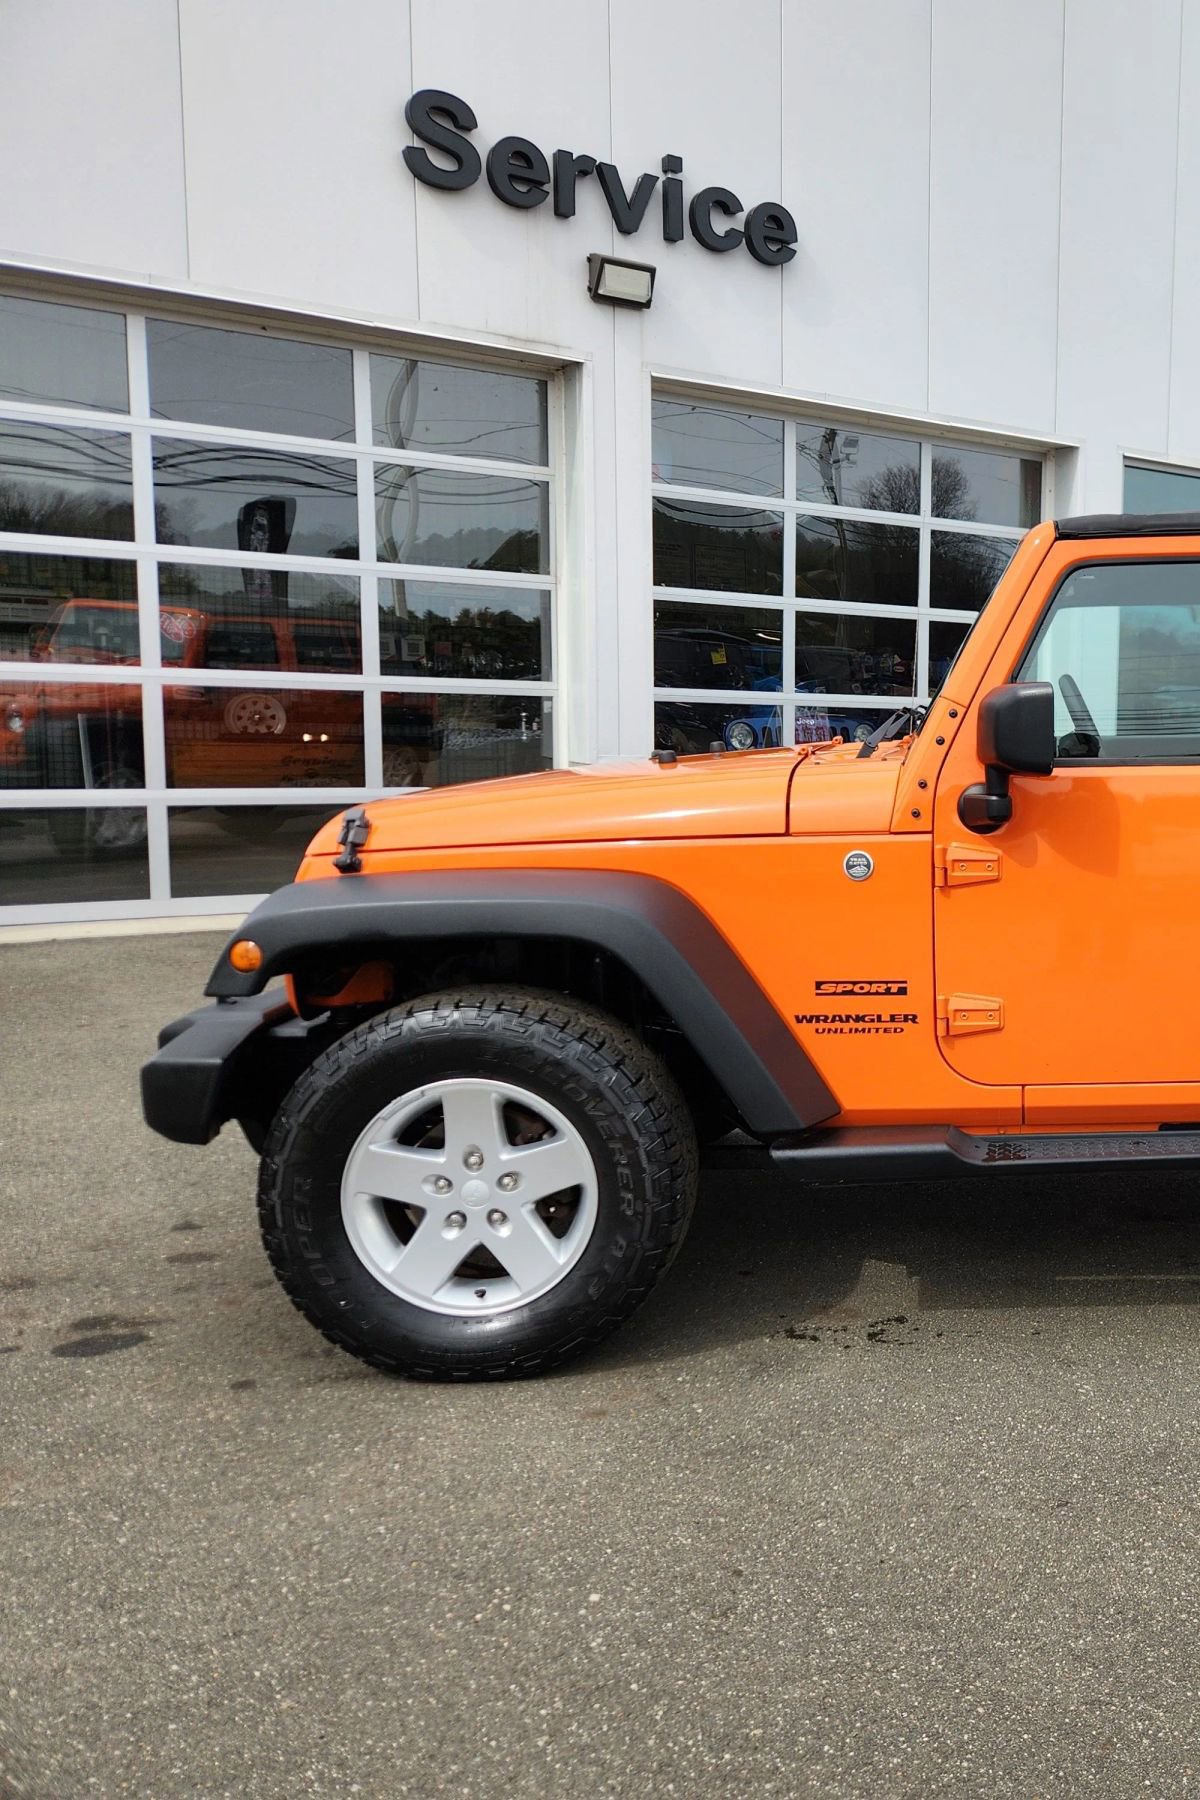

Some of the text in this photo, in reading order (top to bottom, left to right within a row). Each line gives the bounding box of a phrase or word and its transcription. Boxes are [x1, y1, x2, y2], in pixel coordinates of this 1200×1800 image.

[402, 88, 799, 267] Service
[815, 981, 907, 995] SPORT
[794, 1013, 919, 1024] WRANGLER
[814, 1026, 905, 1035] UNLIMITED
